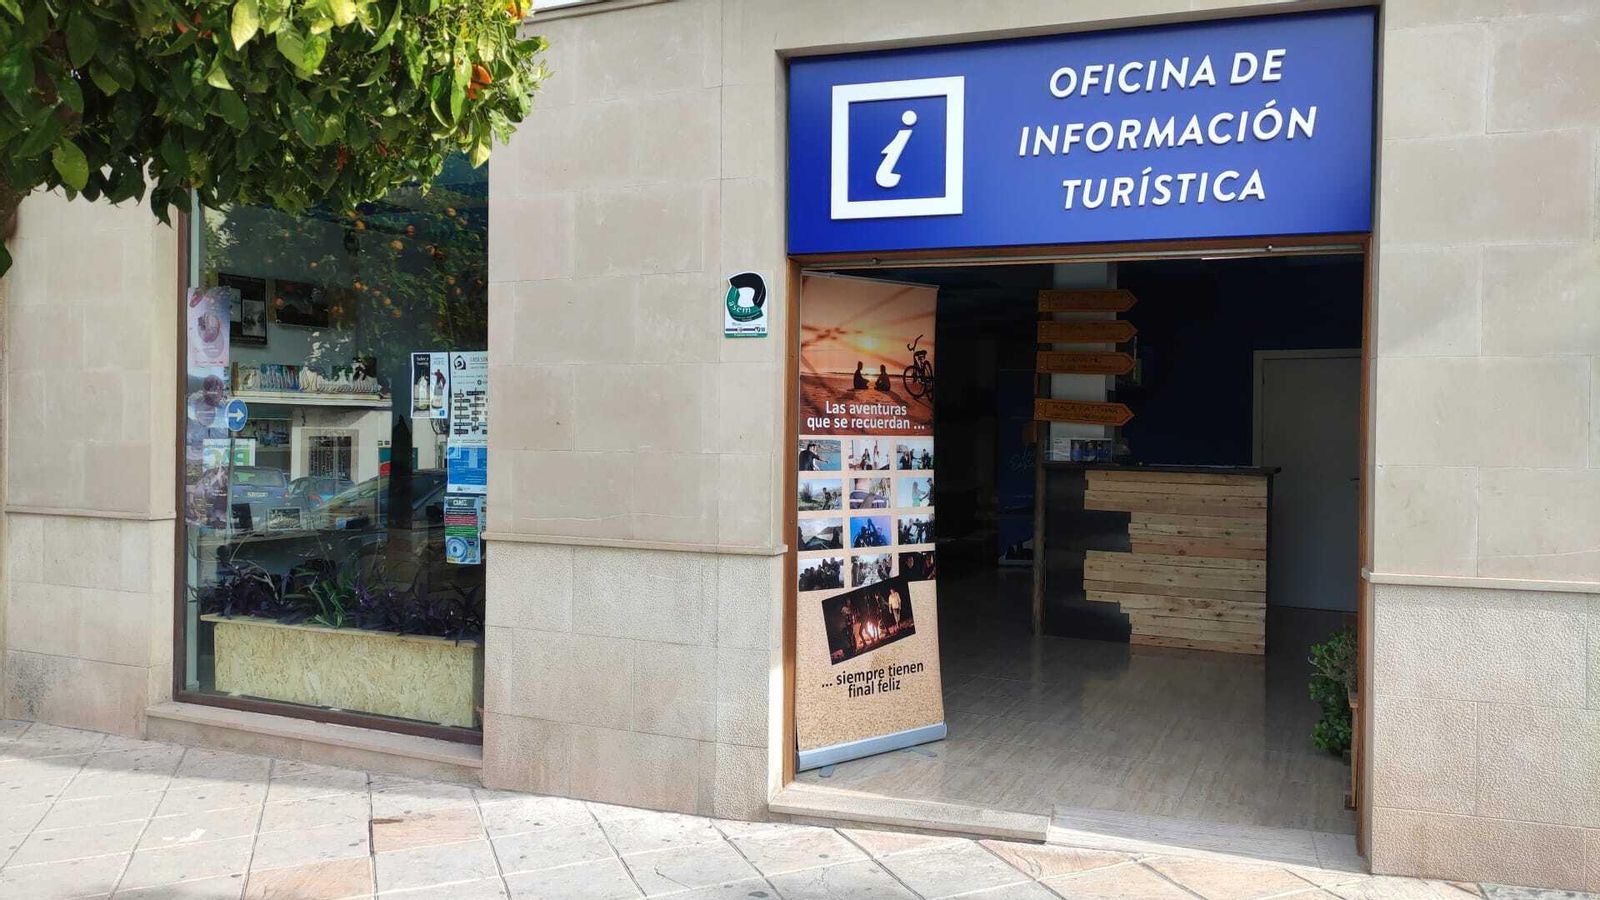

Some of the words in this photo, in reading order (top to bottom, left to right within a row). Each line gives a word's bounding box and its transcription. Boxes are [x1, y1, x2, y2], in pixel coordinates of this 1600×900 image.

[1050, 55, 1216, 98] OFICINA
[1230, 49, 1286, 85] DE
[1019, 99, 1317, 157] INFORMACIÓN
[1062, 166, 1266, 209] TURÍSTICA
[826, 401, 846, 415] Las
[849, 404, 907, 416] aventuras
[807, 416, 831, 431] que
[834, 418, 848, 429] se
[851, 415, 911, 430] recuerdan
[836, 669, 885, 685] siempre
[888, 662, 924, 677] tienen
[848, 681, 874, 698] final
[877, 679, 901, 693] feliz
